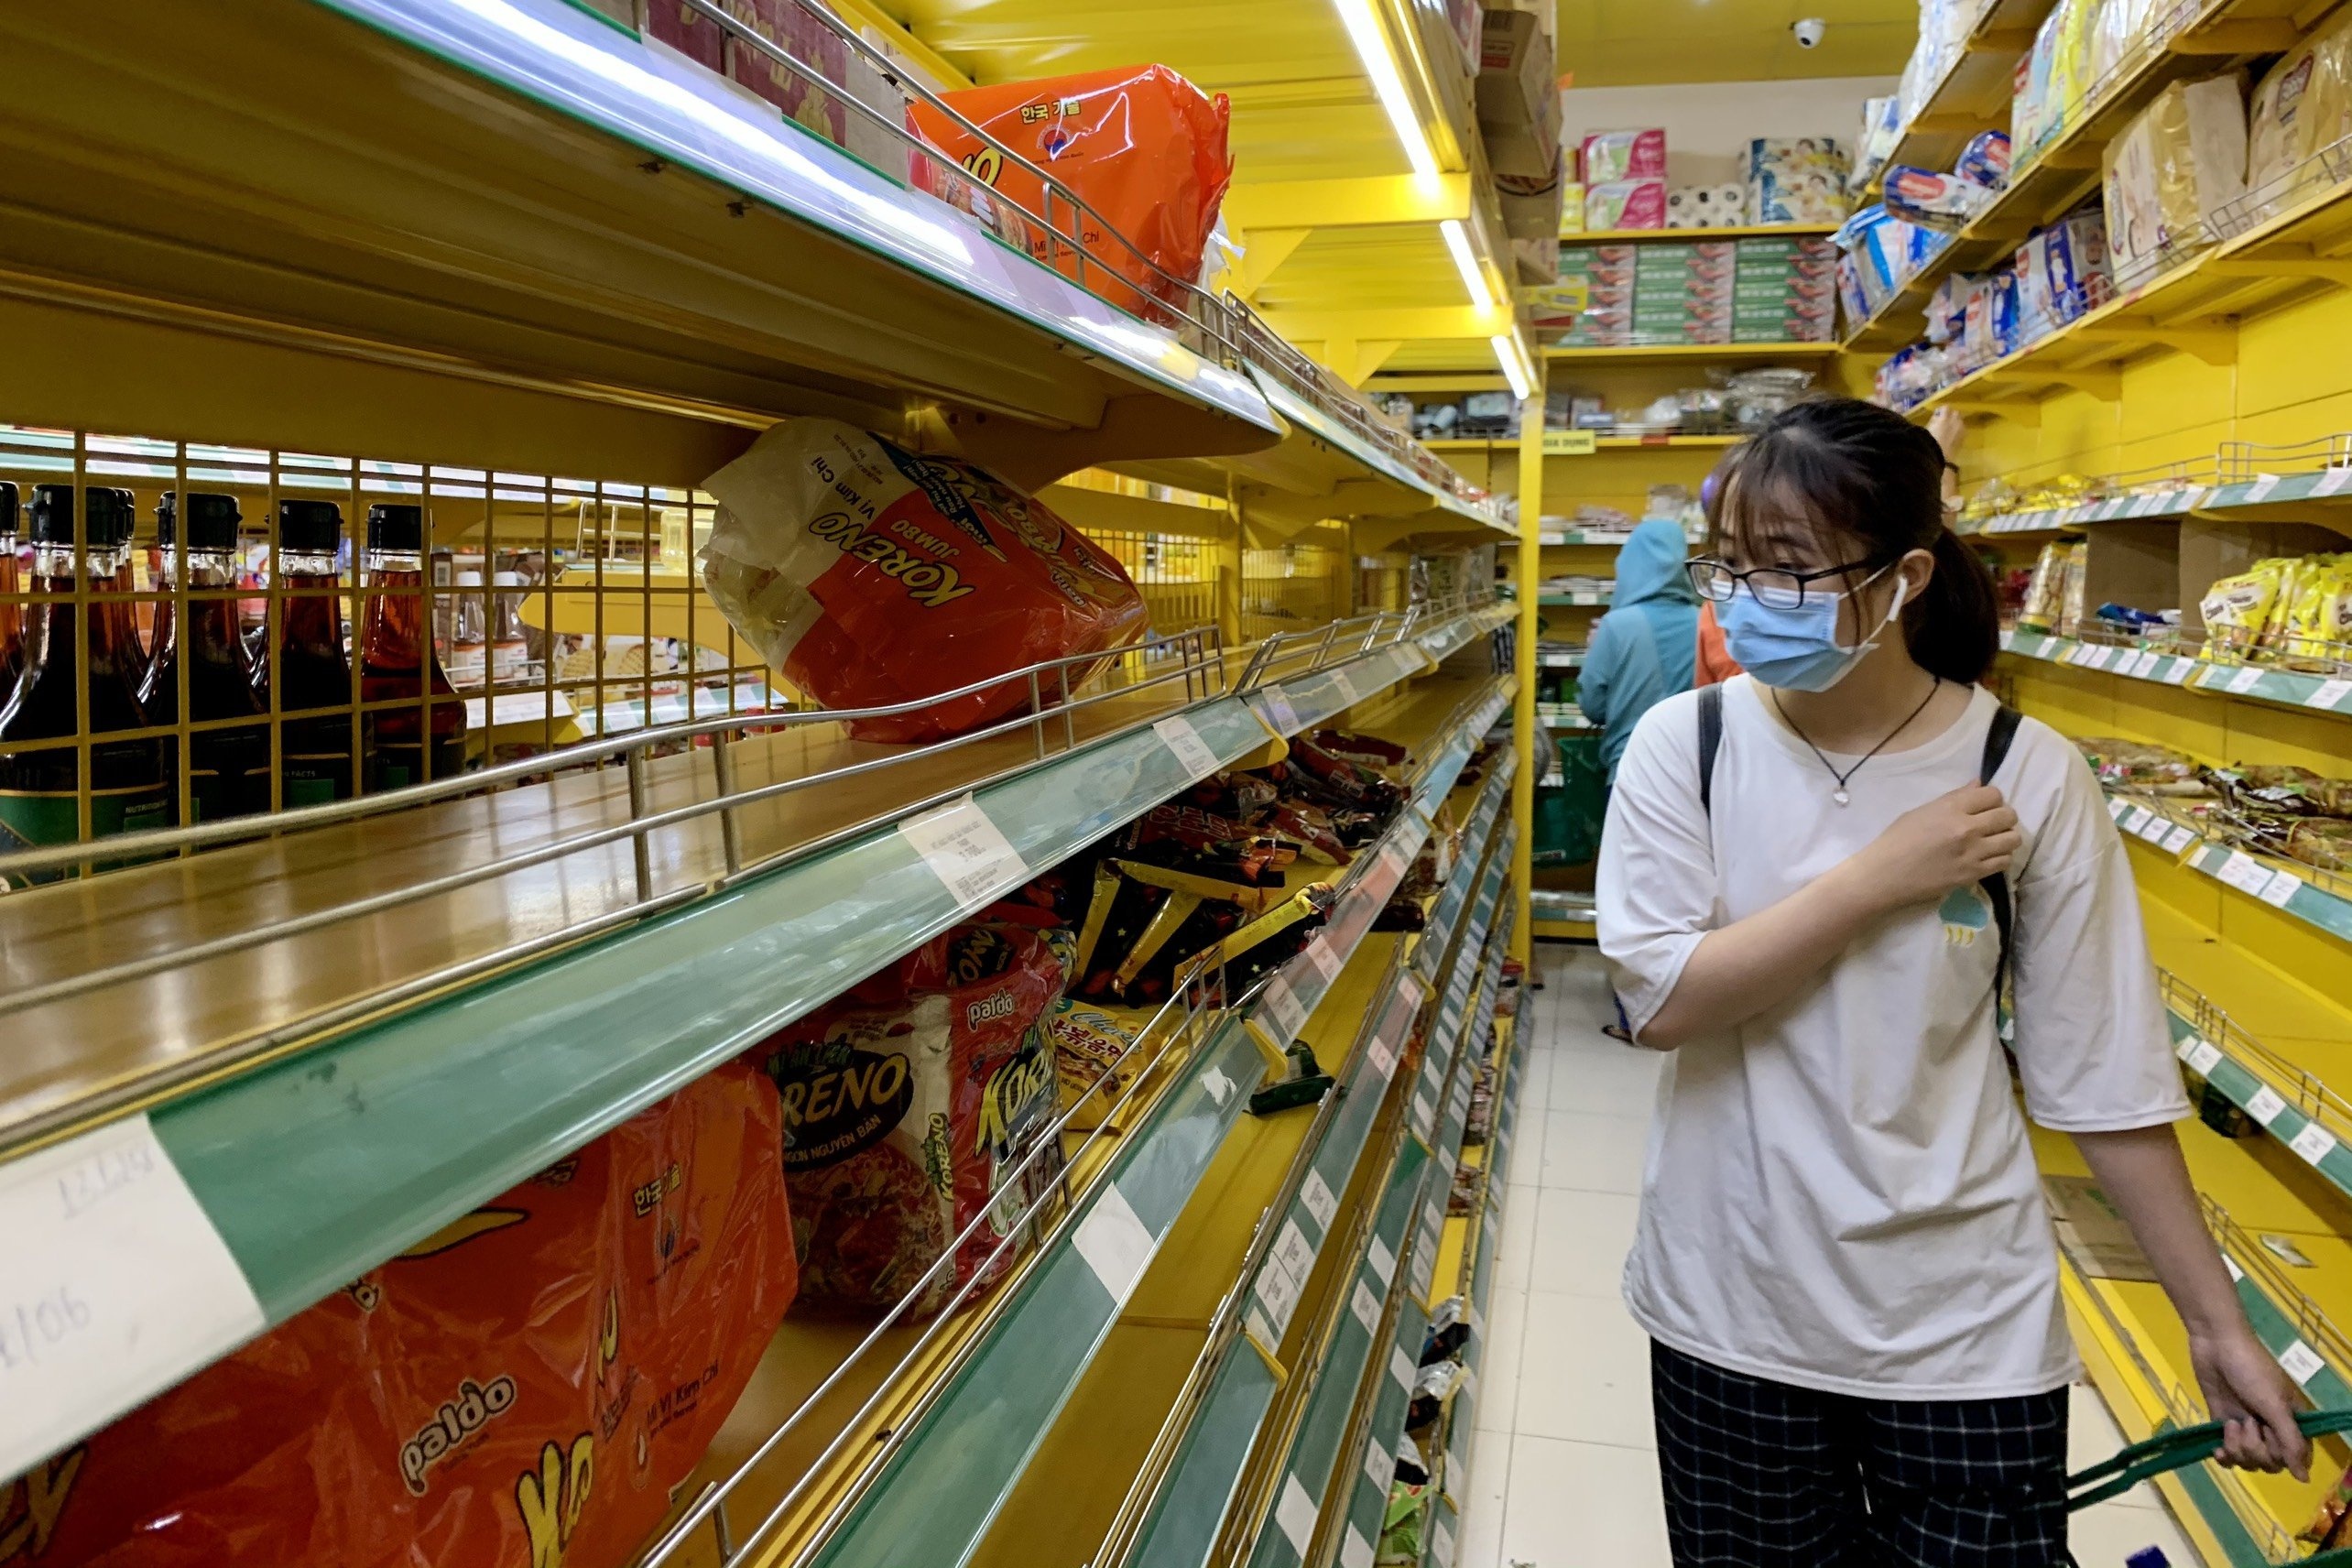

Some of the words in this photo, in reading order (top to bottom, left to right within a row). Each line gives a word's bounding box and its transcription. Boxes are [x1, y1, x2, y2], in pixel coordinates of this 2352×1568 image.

[1020, 103, 1050, 125] 한국
[810, 455, 834, 485] Chi
[834, 479, 860, 508] Kim
[857, 495, 877, 522] Vị
[807, 510, 976, 609] KORENO
[888, 517, 962, 561] JUMBO
[965, 989, 1015, 1032] paldo
[928, 1112, 954, 1203] KORENO
[398, 1373, 519, 1498] paldo
